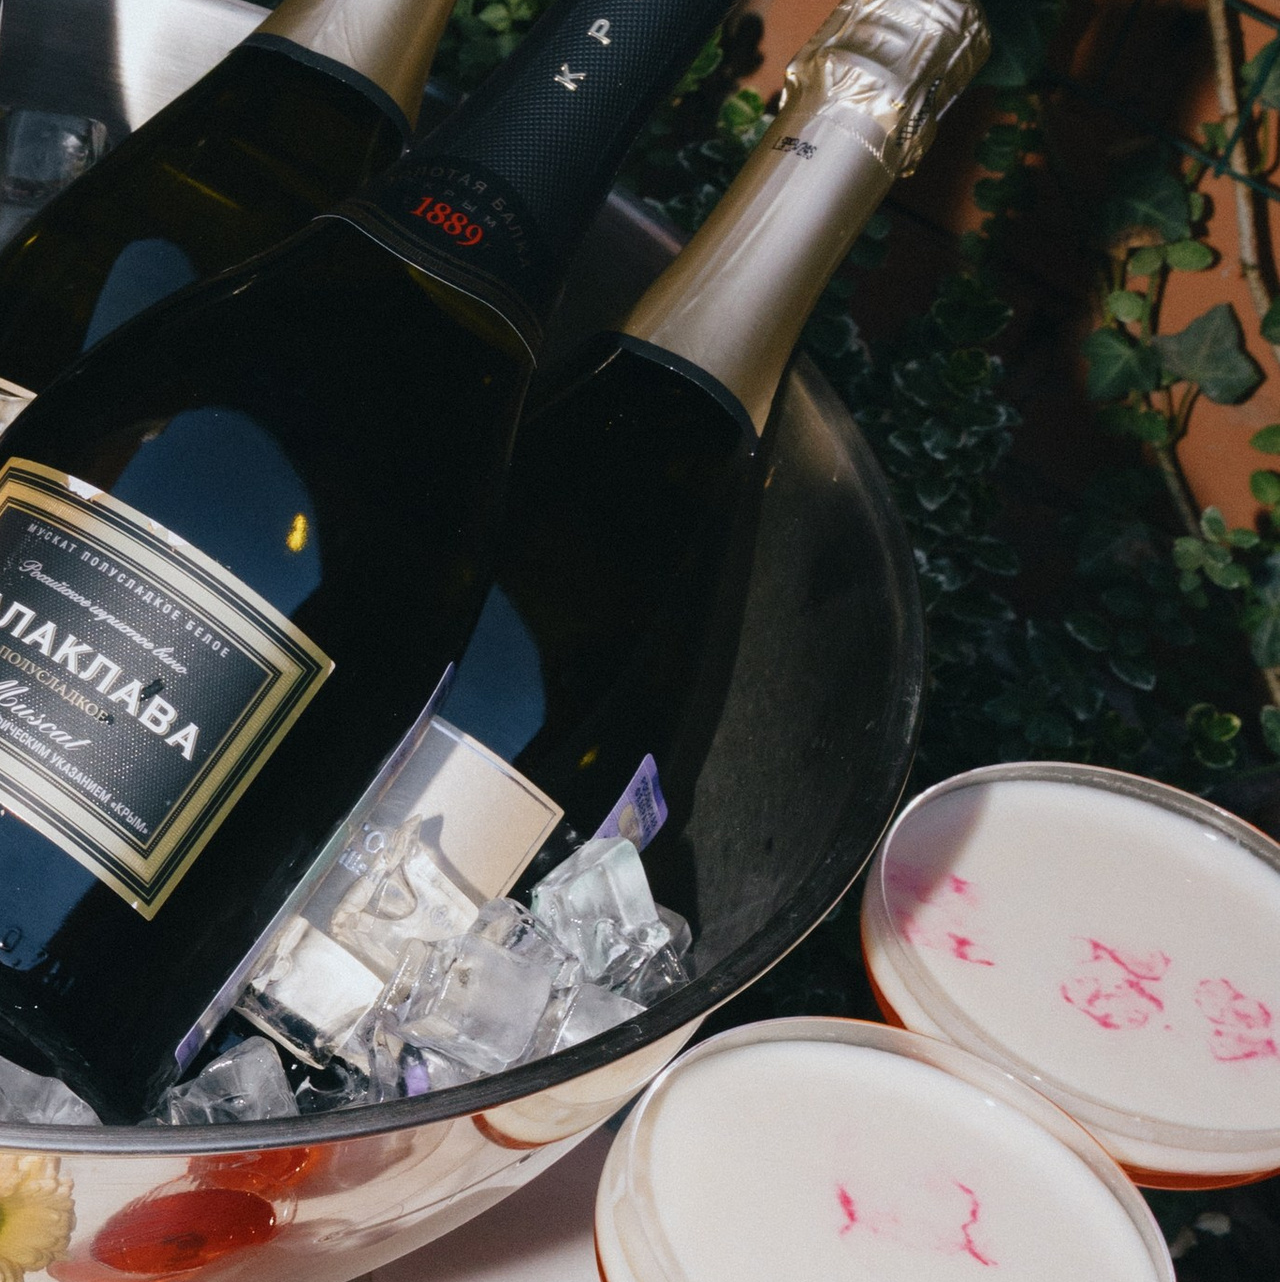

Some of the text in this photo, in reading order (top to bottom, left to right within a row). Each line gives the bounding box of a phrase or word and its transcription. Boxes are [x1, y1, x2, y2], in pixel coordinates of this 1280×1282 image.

[410, 196, 484, 246] 1889
[19, 560, 188, 675] Российское игристое вино
[27, 523, 231, 658] МУСКАТ ПОЛУСЛАДКОЕ БЕЛОЕ
[50, 752, 113, 804] УКАЗАНИЕМ
[110, 800, 149, 835] «КРЫМ»
